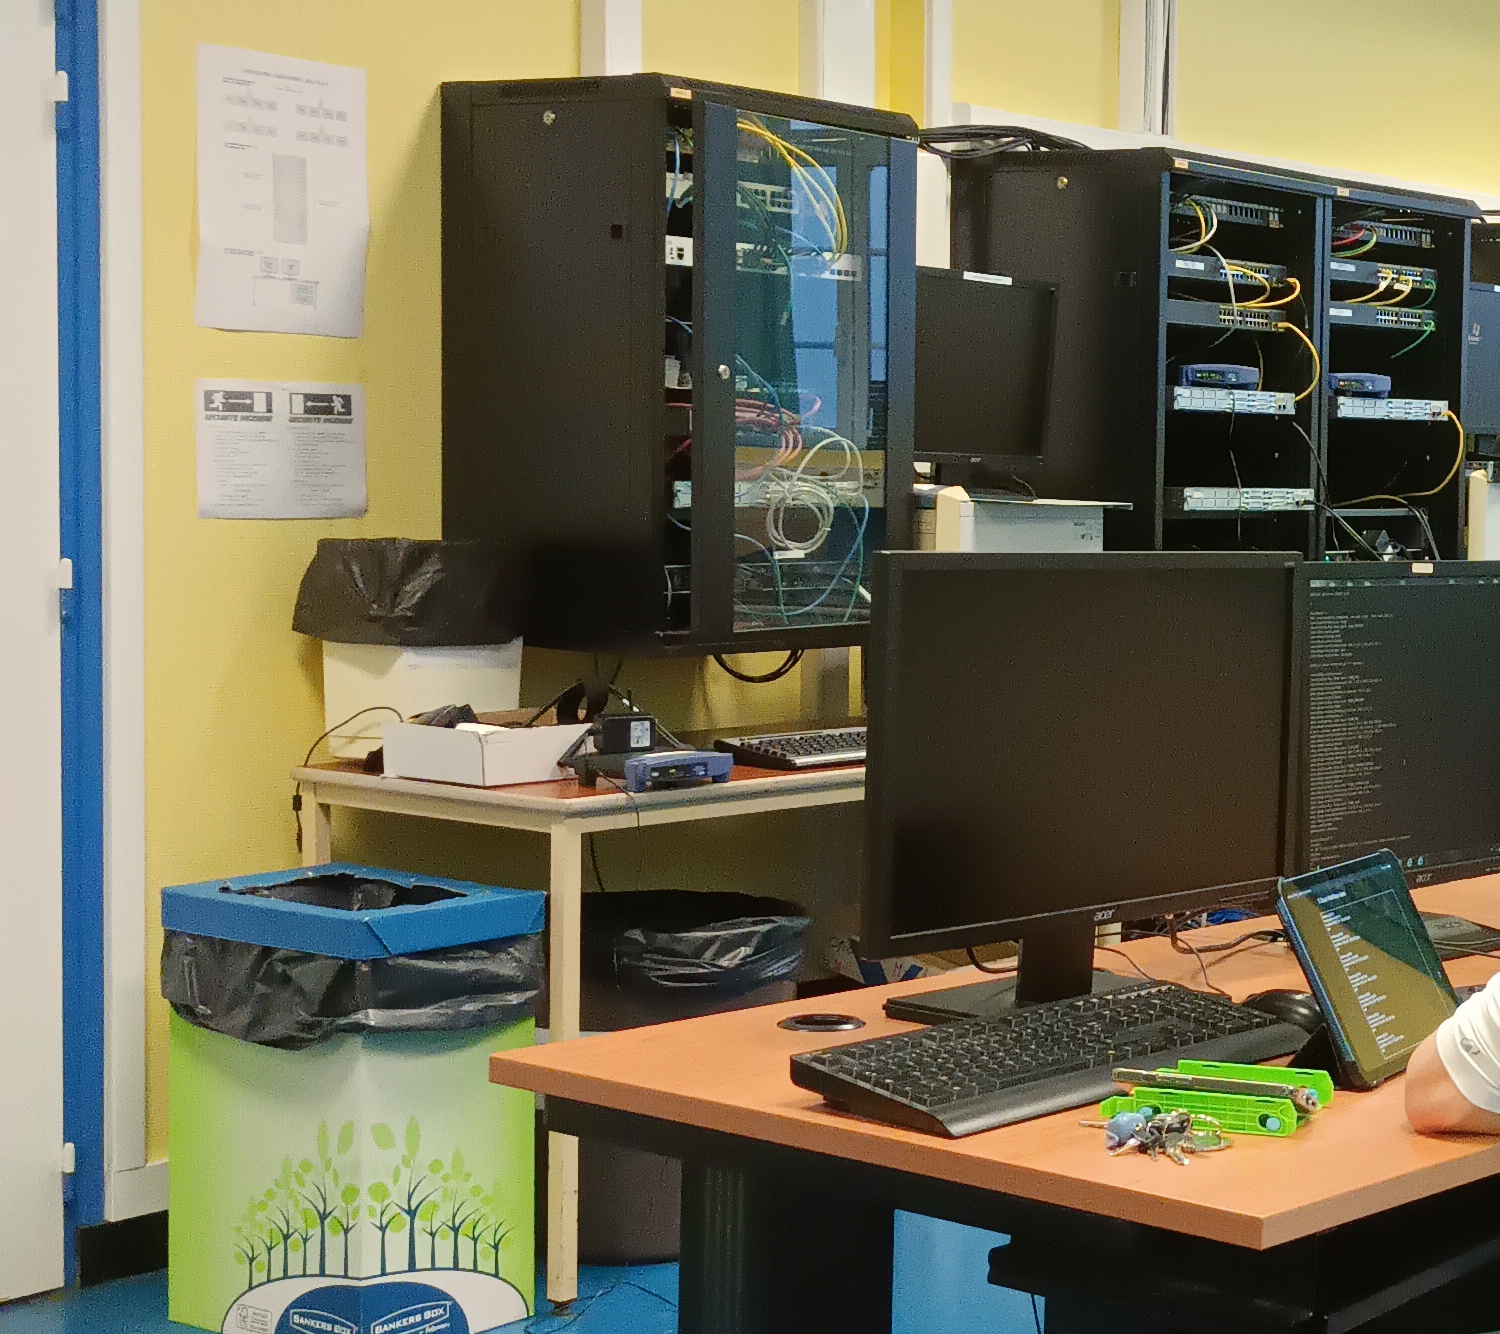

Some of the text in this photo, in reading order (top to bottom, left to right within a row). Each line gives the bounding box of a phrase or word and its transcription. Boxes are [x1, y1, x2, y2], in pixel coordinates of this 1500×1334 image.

[293, 1314, 332, 1331] BANKERS
[374, 1314, 422, 1334] BANKERS
[423, 1306, 445, 1320] BOX
